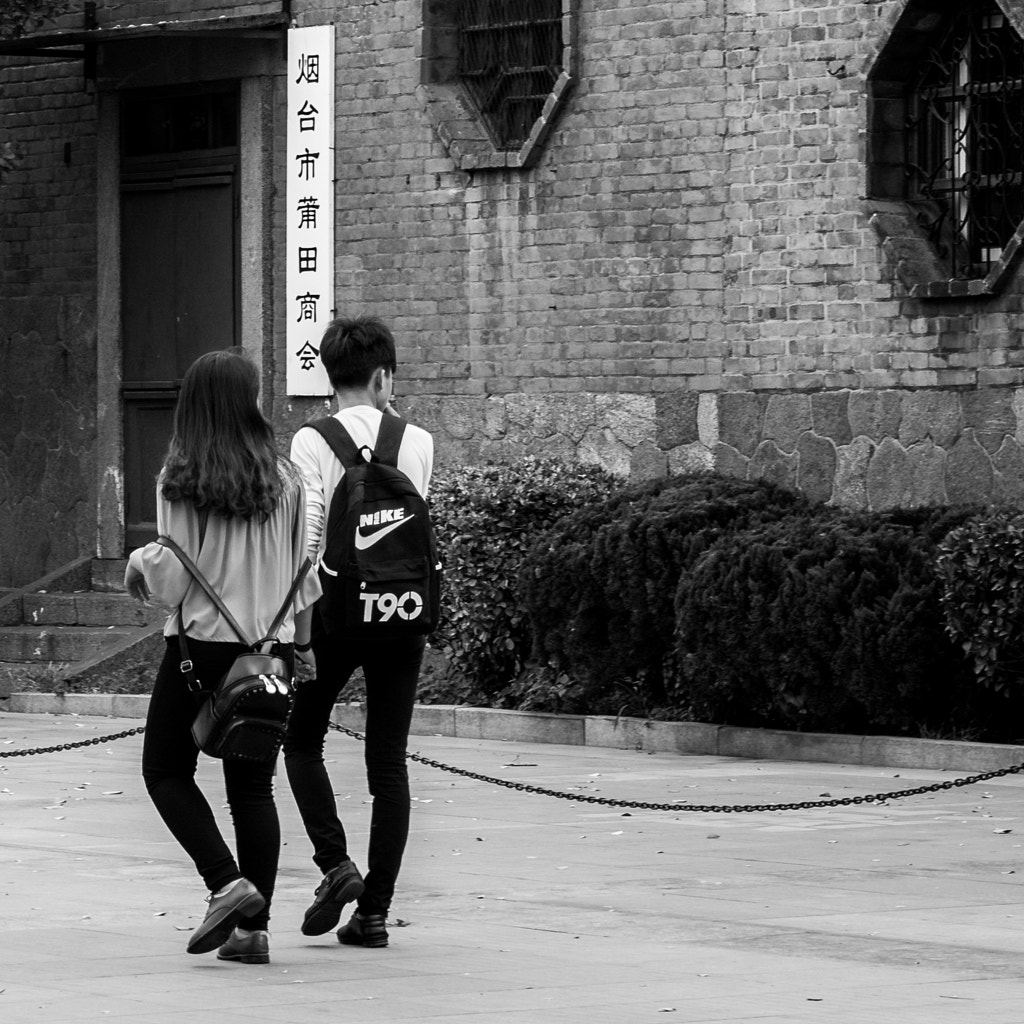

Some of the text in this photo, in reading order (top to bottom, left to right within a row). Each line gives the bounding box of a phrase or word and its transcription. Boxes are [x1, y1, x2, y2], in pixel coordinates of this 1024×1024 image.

[295, 53, 320, 371] 烟台市莆田商会
[359, 507, 404, 528] NIKE
[359, 591, 423, 623] T90
